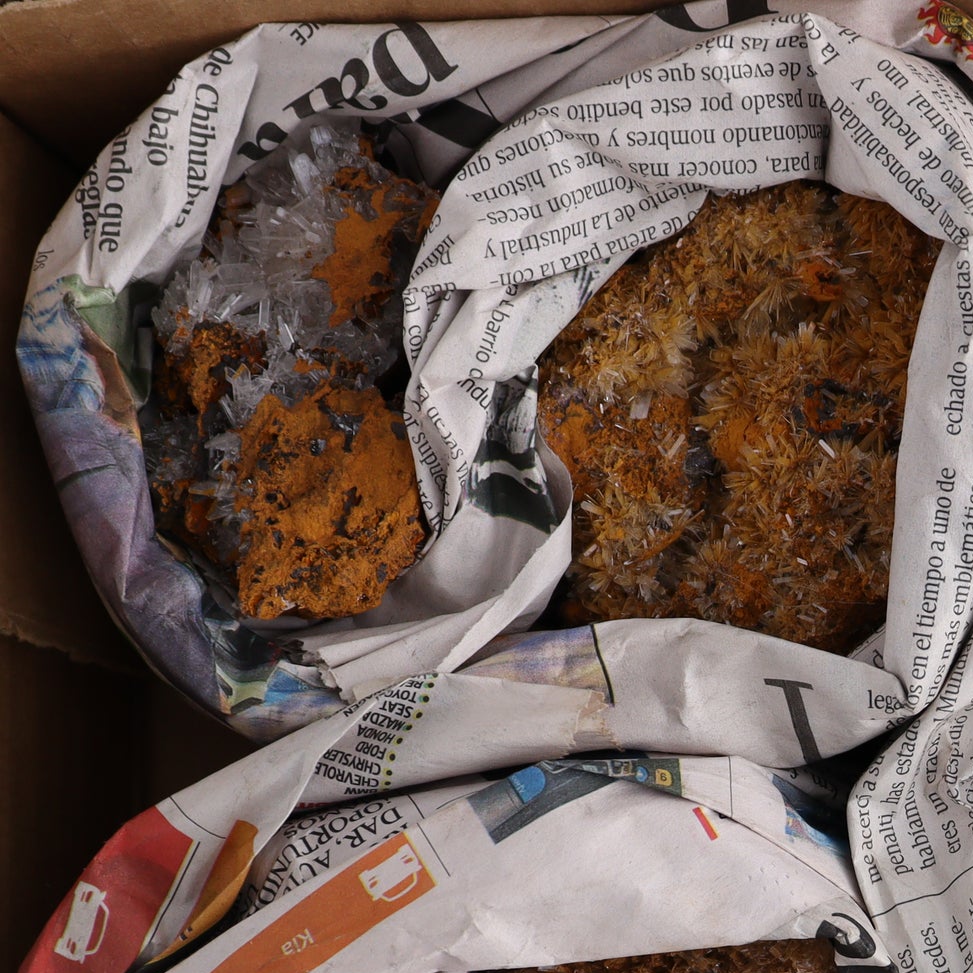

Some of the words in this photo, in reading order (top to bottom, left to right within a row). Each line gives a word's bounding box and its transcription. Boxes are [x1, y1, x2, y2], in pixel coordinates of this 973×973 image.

[658, 66, 695, 82] que
[701, 63, 774, 82] eventos
[878, 60, 908, 90] uno
[851, 78, 871, 91] y
[568, 100, 643, 122] bendito
[651, 98, 691, 115] este
[700, 92, 733, 111] por
[742, 91, 802, 114] pasado
[866, 91, 921, 150] hechos
[142, 105, 178, 166] bajo
[608, 128, 618, 146] y
[627, 129, 715, 150] nombres
[826, 97, 942, 214] responsabilidad
[919, 148, 941, 169] de
[548, 159, 570, 178] su
[628, 163, 669, 177] más
[678, 159, 757, 176] conocer
[478, 204, 542, 224] neces-
[592, 213, 611, 230] La
[615, 204, 635, 222] de
[98, 203, 123, 252] que
[939, 210, 970, 248] gran
[485, 238, 496, 258] y
[500, 220, 587, 260] Industrial
[605, 226, 656, 254] arena
[944, 362, 967, 435] echado
[936, 468, 956, 492] de
[933, 497, 951, 534] uno
[916, 556, 945, 627] tiempo
[913, 632, 932, 650] el
[912, 656, 928, 679] en
[379, 701, 413, 718] SEAT
[362, 713, 404, 730] MAZDA
[357, 724, 395, 743] HONDA
[356, 742, 386, 759] FORD
[323, 749, 380, 775] CHRYSLER
[883, 782, 905, 804] has
[336, 808, 402, 848] DAR,
[942, 820, 960, 853] eres
[881, 811, 912, 875] penalti,
[281, 929, 315, 957] Kia
